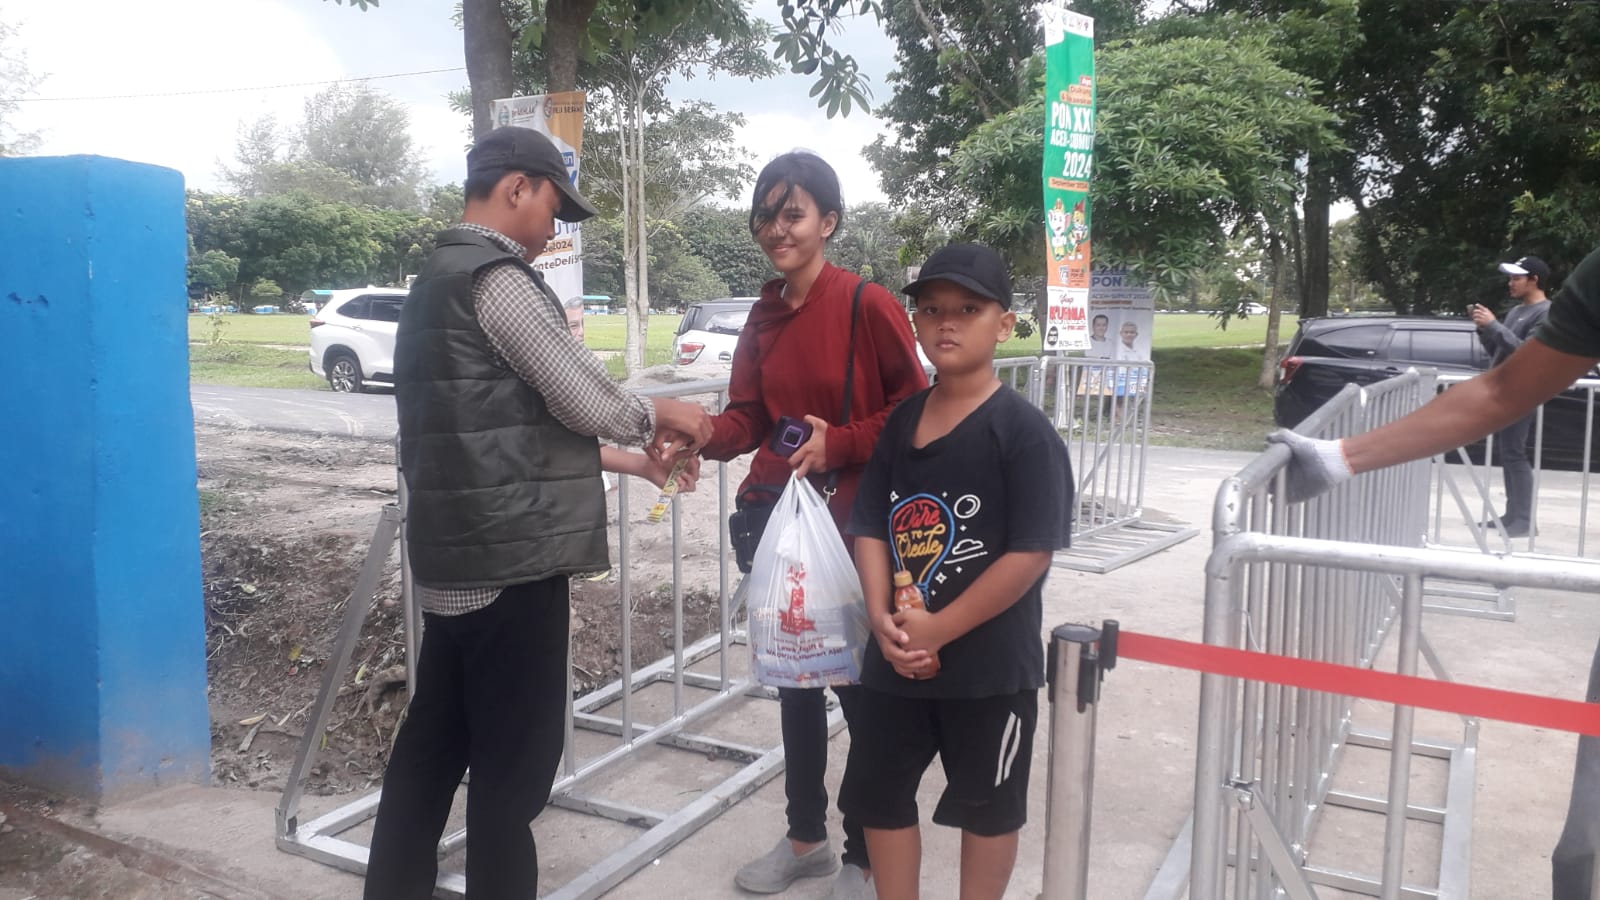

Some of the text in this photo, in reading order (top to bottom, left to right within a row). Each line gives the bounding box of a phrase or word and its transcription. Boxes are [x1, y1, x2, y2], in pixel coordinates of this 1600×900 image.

[1052, 102, 1072, 130] PON
[1063, 152, 1092, 178] 2024
[1092, 277, 1122, 287] PON
